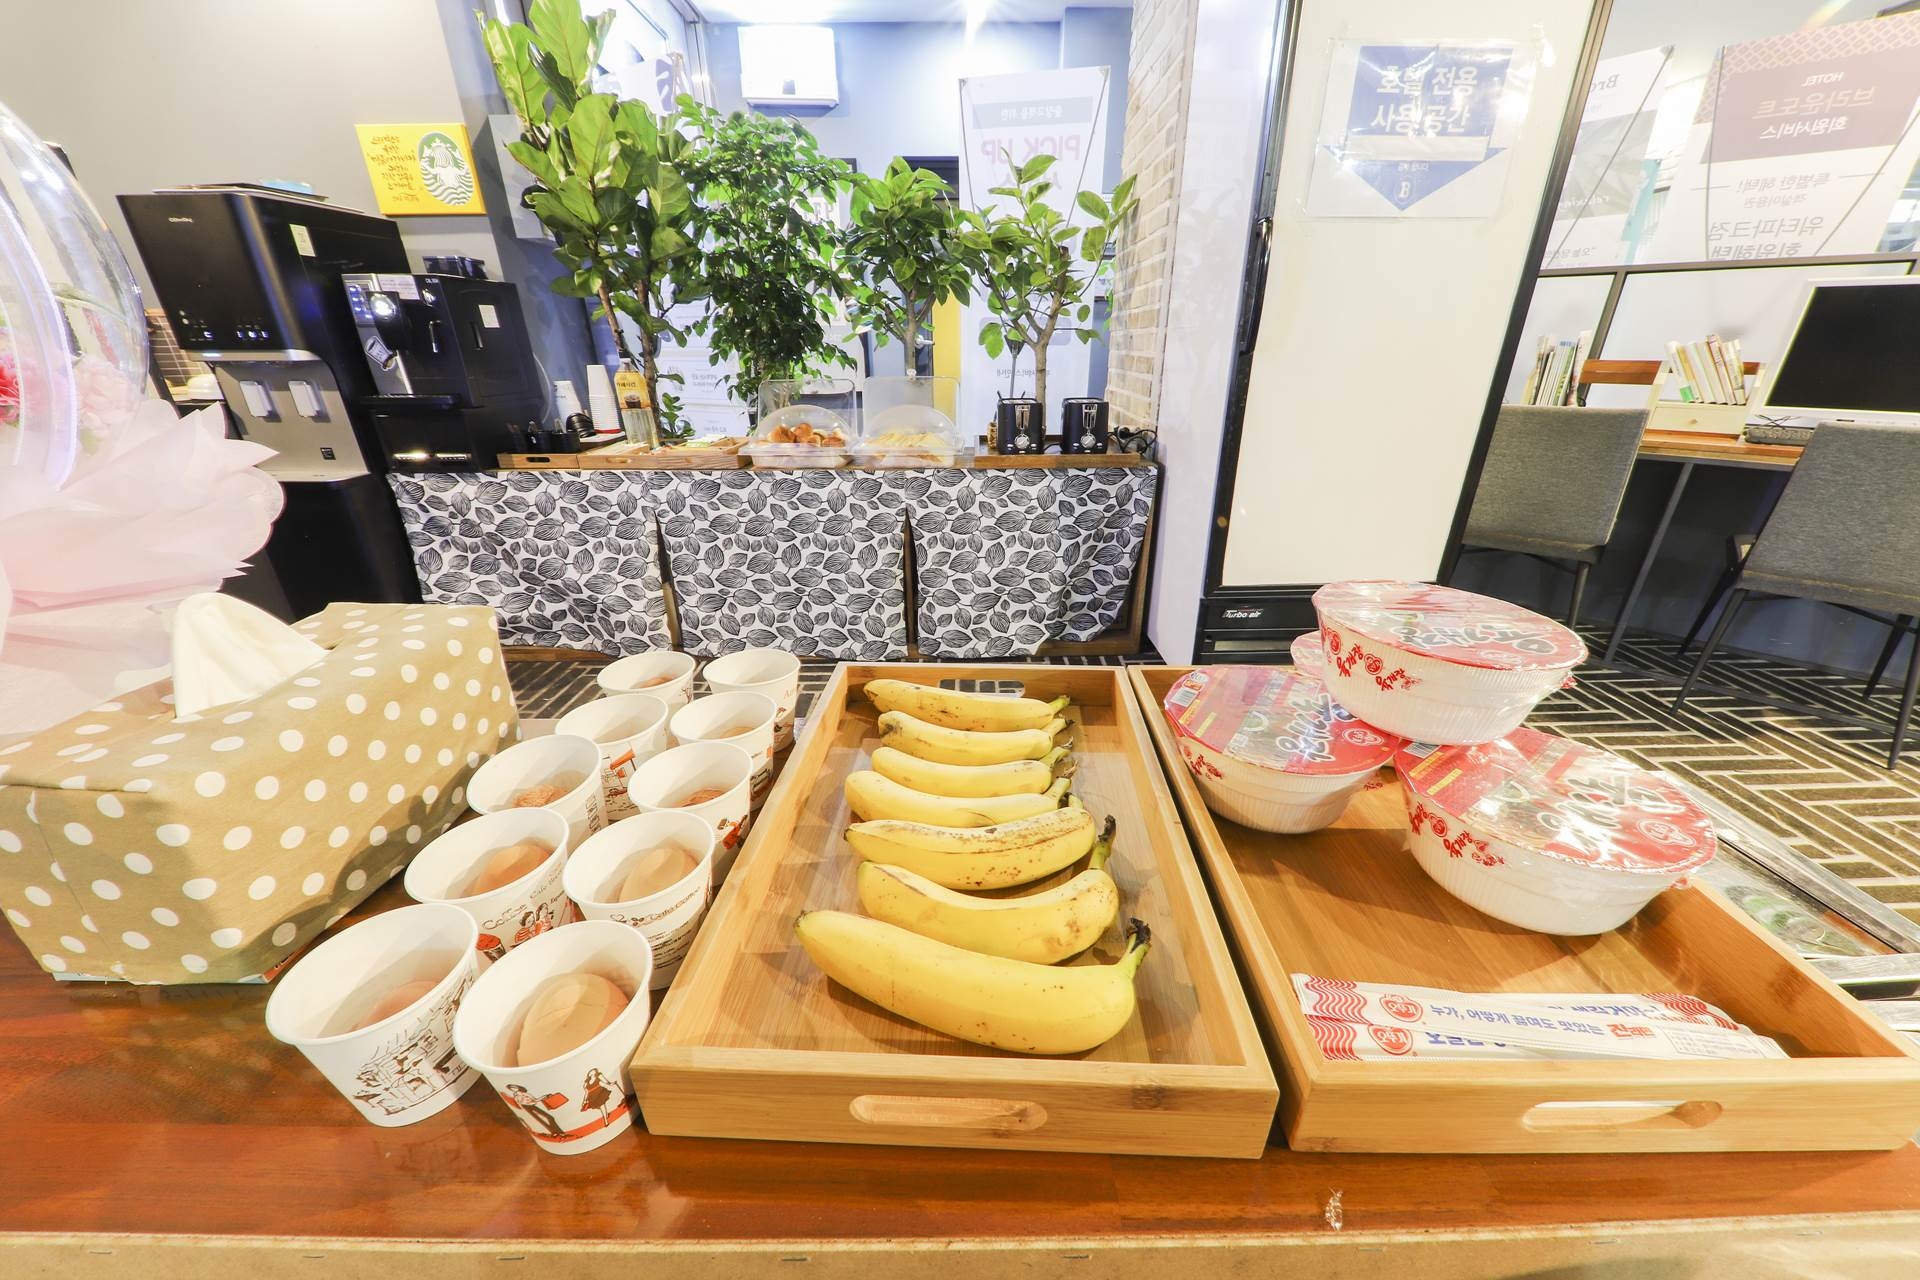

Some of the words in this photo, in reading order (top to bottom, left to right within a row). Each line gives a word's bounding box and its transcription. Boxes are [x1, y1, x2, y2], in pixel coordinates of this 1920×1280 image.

[1431, 66, 1478, 96] 전용
[1225, 609, 1247, 618] Turbo
[1430, 1004, 1464, 1020] 누가,
[1468, 1009, 1510, 1025] 어떻게
[1557, 1019, 1606, 1036] 맛있는
